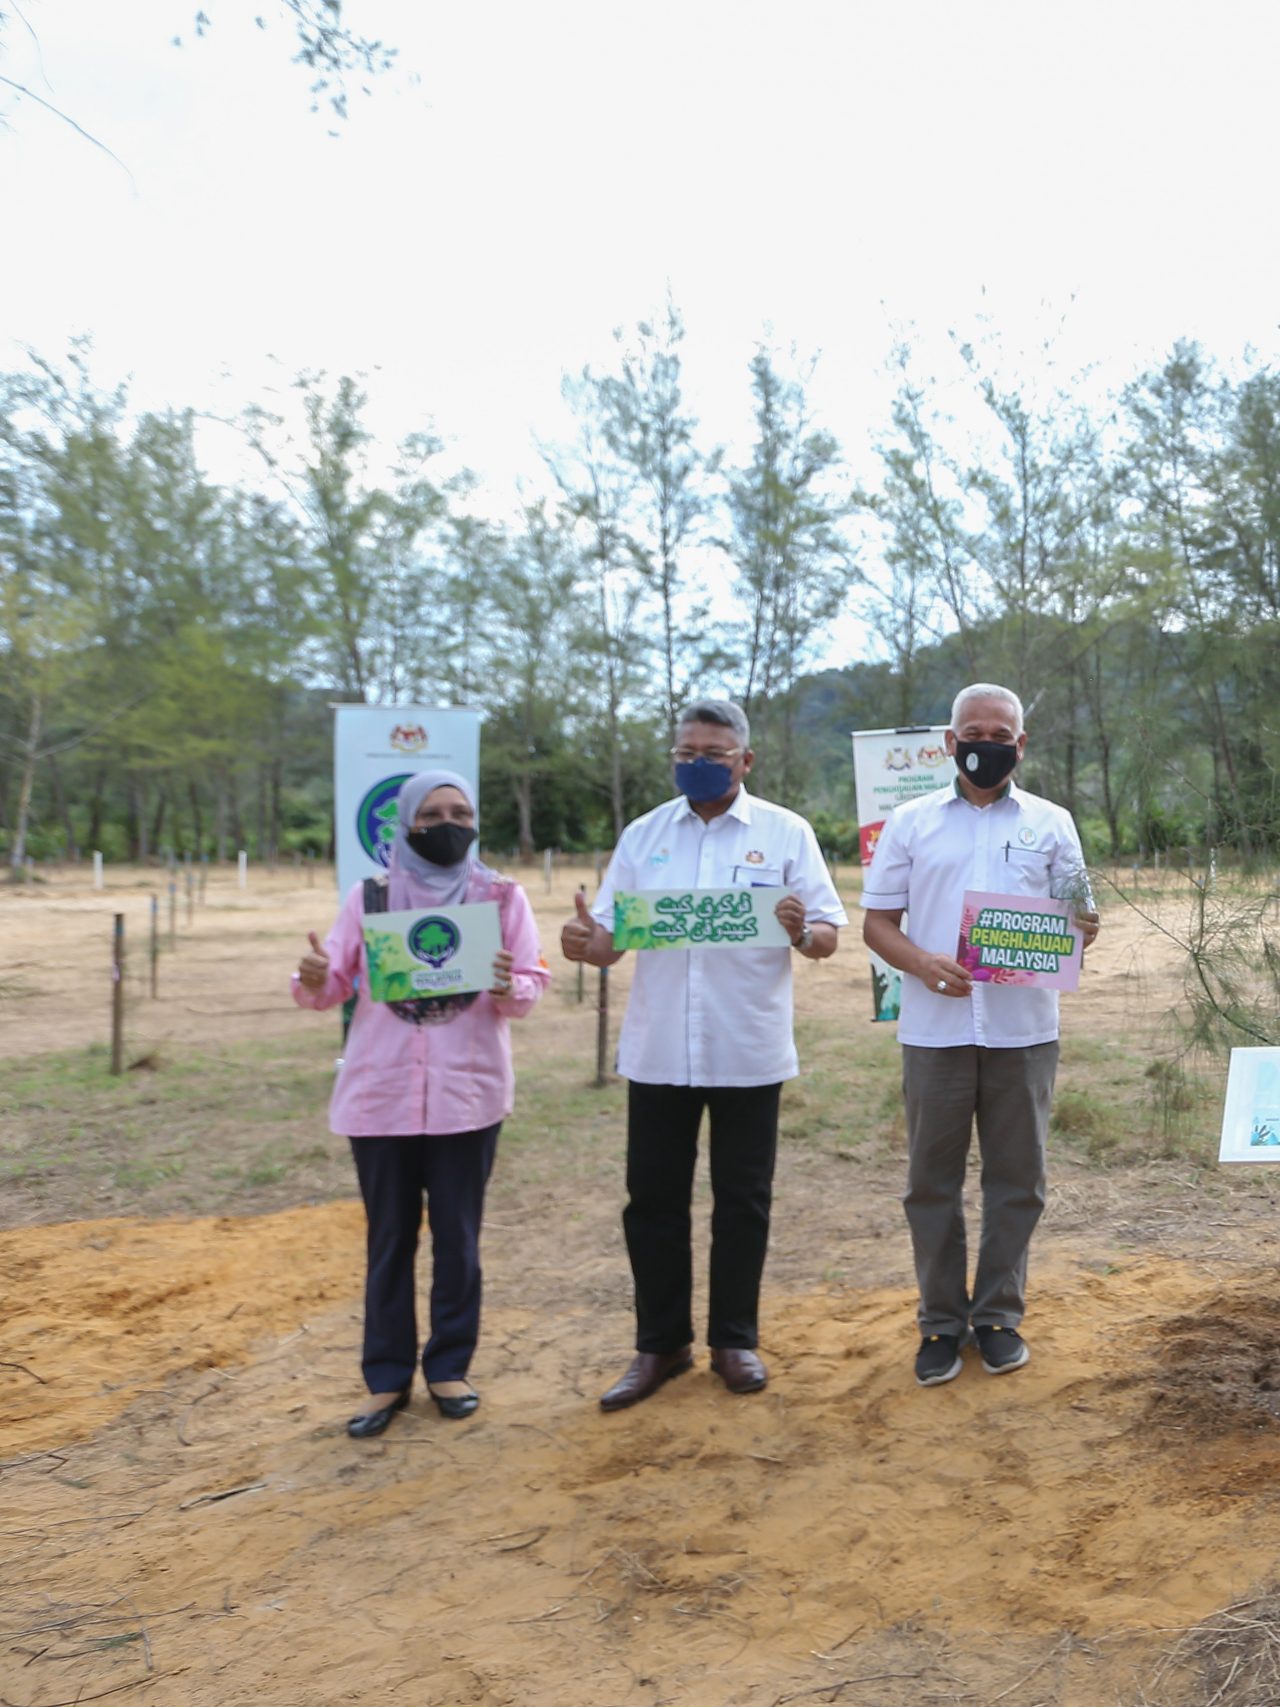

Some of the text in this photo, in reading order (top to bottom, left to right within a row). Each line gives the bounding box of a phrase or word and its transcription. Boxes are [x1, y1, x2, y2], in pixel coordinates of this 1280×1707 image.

[979, 910, 1065, 935] #PROGRAM
[971, 927, 1074, 954] PENGHIJAUAN
[981, 947, 1058, 971] MALAYSIA
